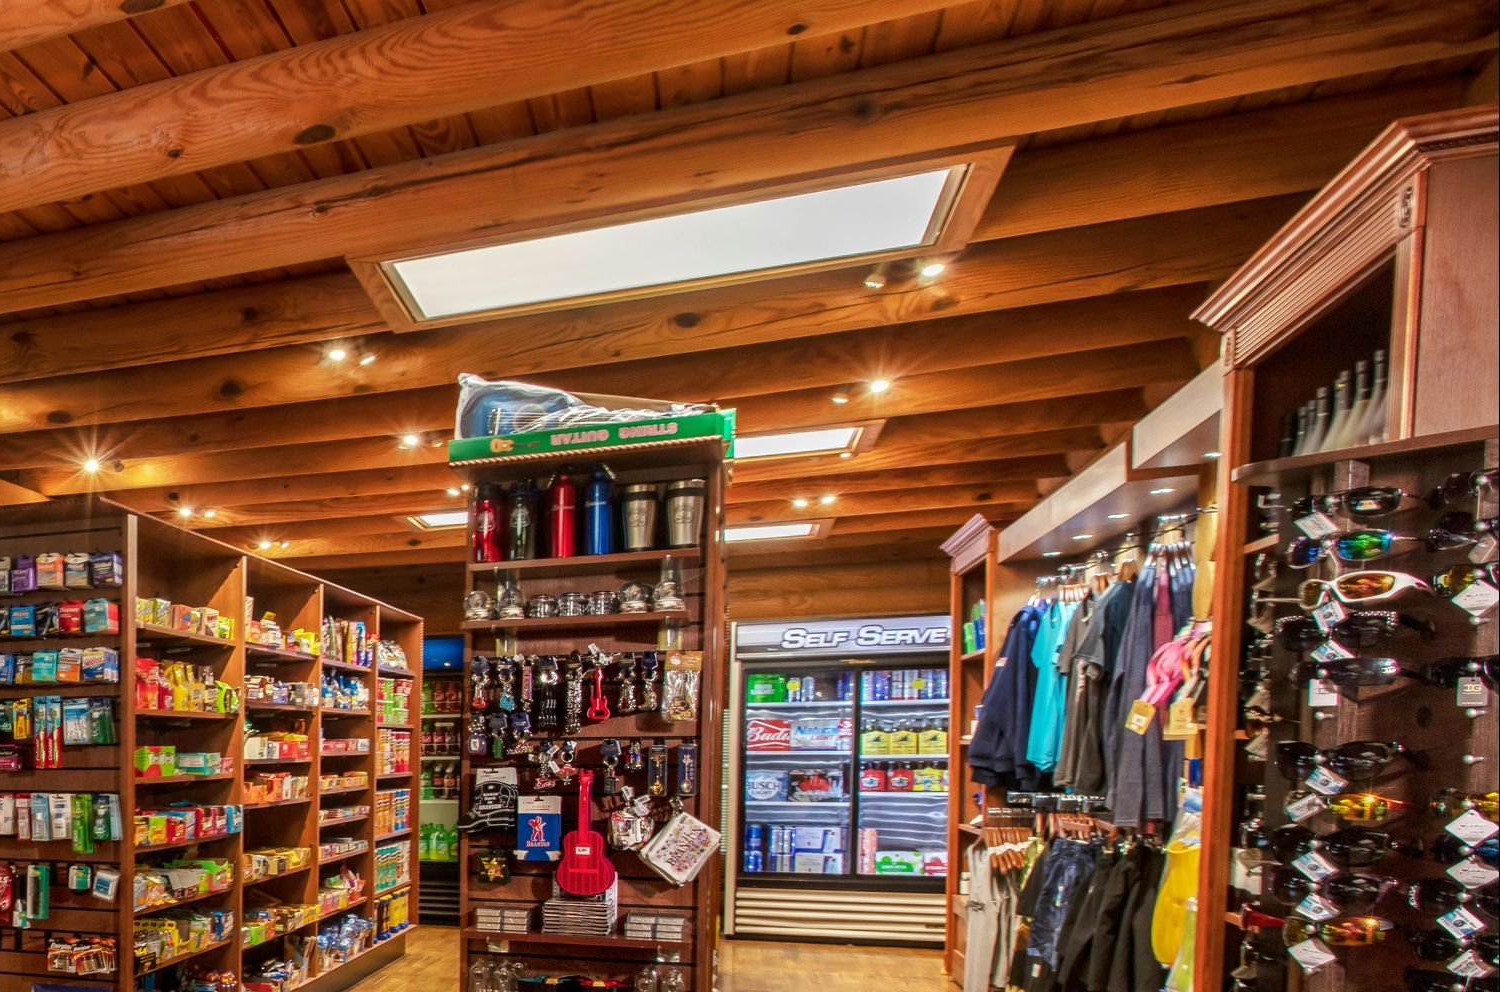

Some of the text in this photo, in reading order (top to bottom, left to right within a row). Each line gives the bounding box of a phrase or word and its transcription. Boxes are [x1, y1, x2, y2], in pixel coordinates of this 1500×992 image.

[552, 422, 678, 445] STRING GUITAR
[781, 625, 948, 648] SELF SERVE
